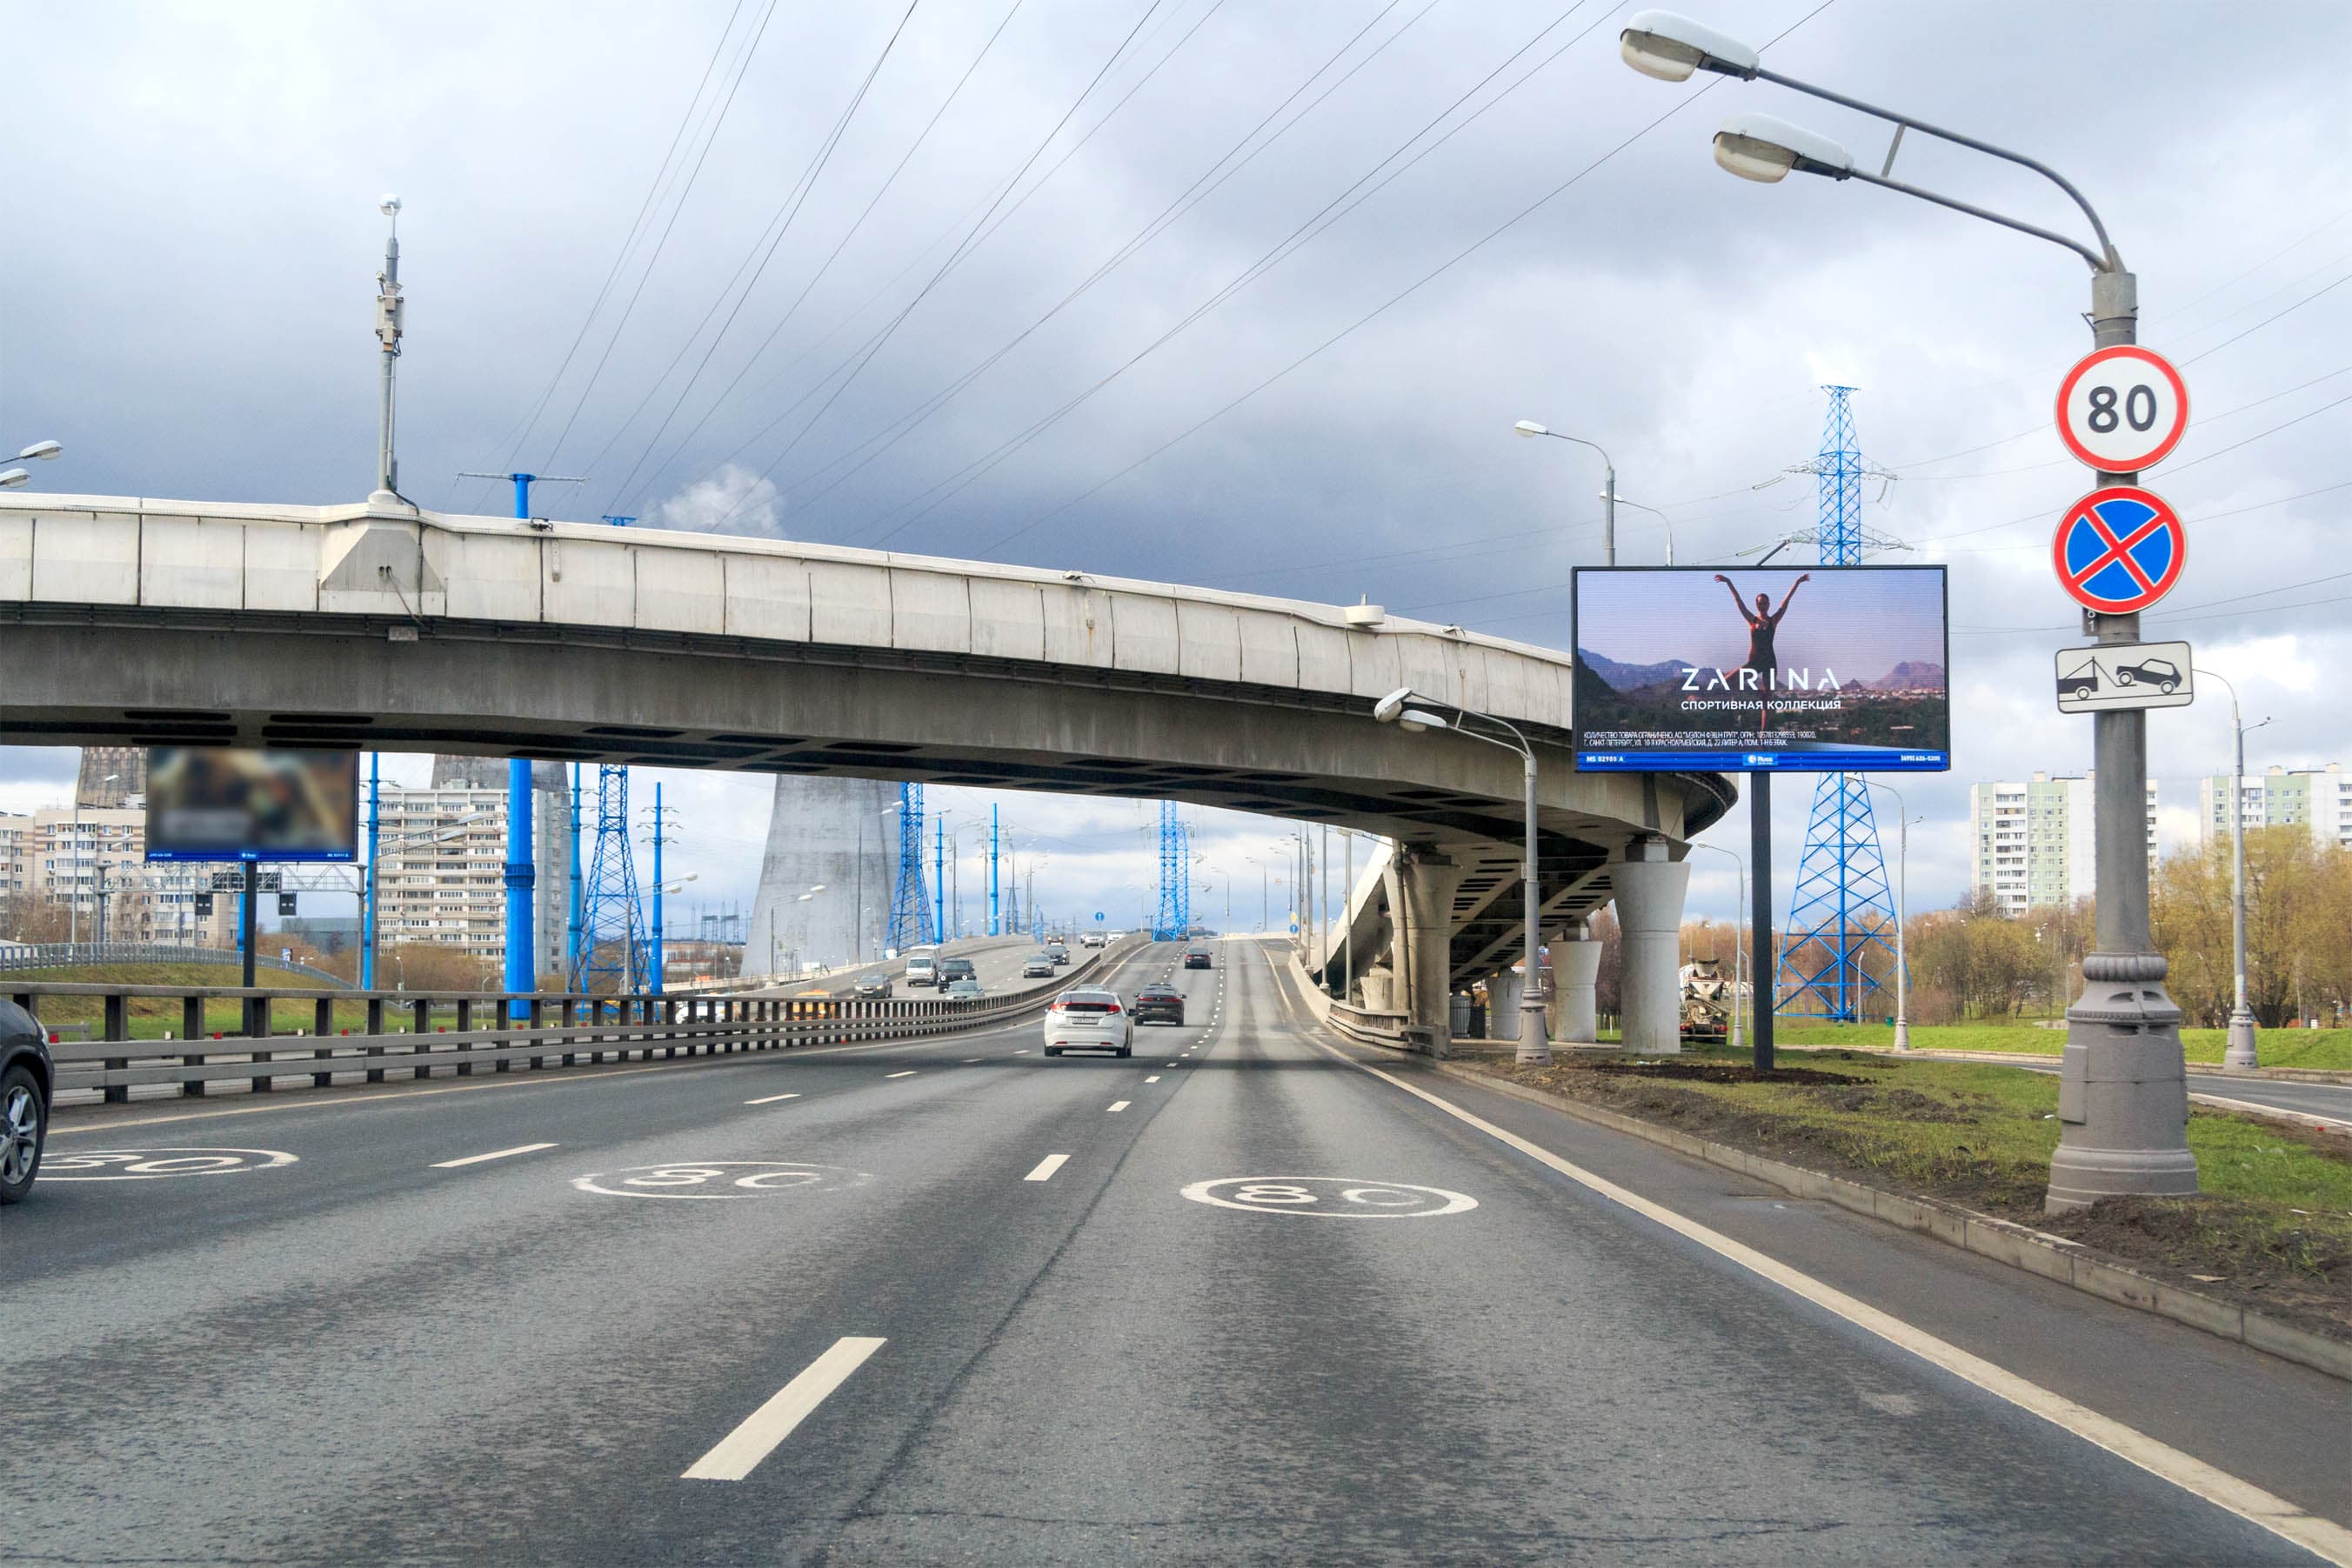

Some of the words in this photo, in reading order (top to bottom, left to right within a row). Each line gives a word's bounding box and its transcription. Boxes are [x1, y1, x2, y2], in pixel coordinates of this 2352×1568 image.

[2088, 384, 2157, 434] 80
[1681, 668, 1841, 691] ZARINA
[1680, 700, 1763, 711] СПОРТИВНАЯ
[1767, 700, 1841, 711] КОЛЛЕКЦИЯ
[624, 1169, 821, 1189] 80
[1234, 1184, 1425, 1206] 80
